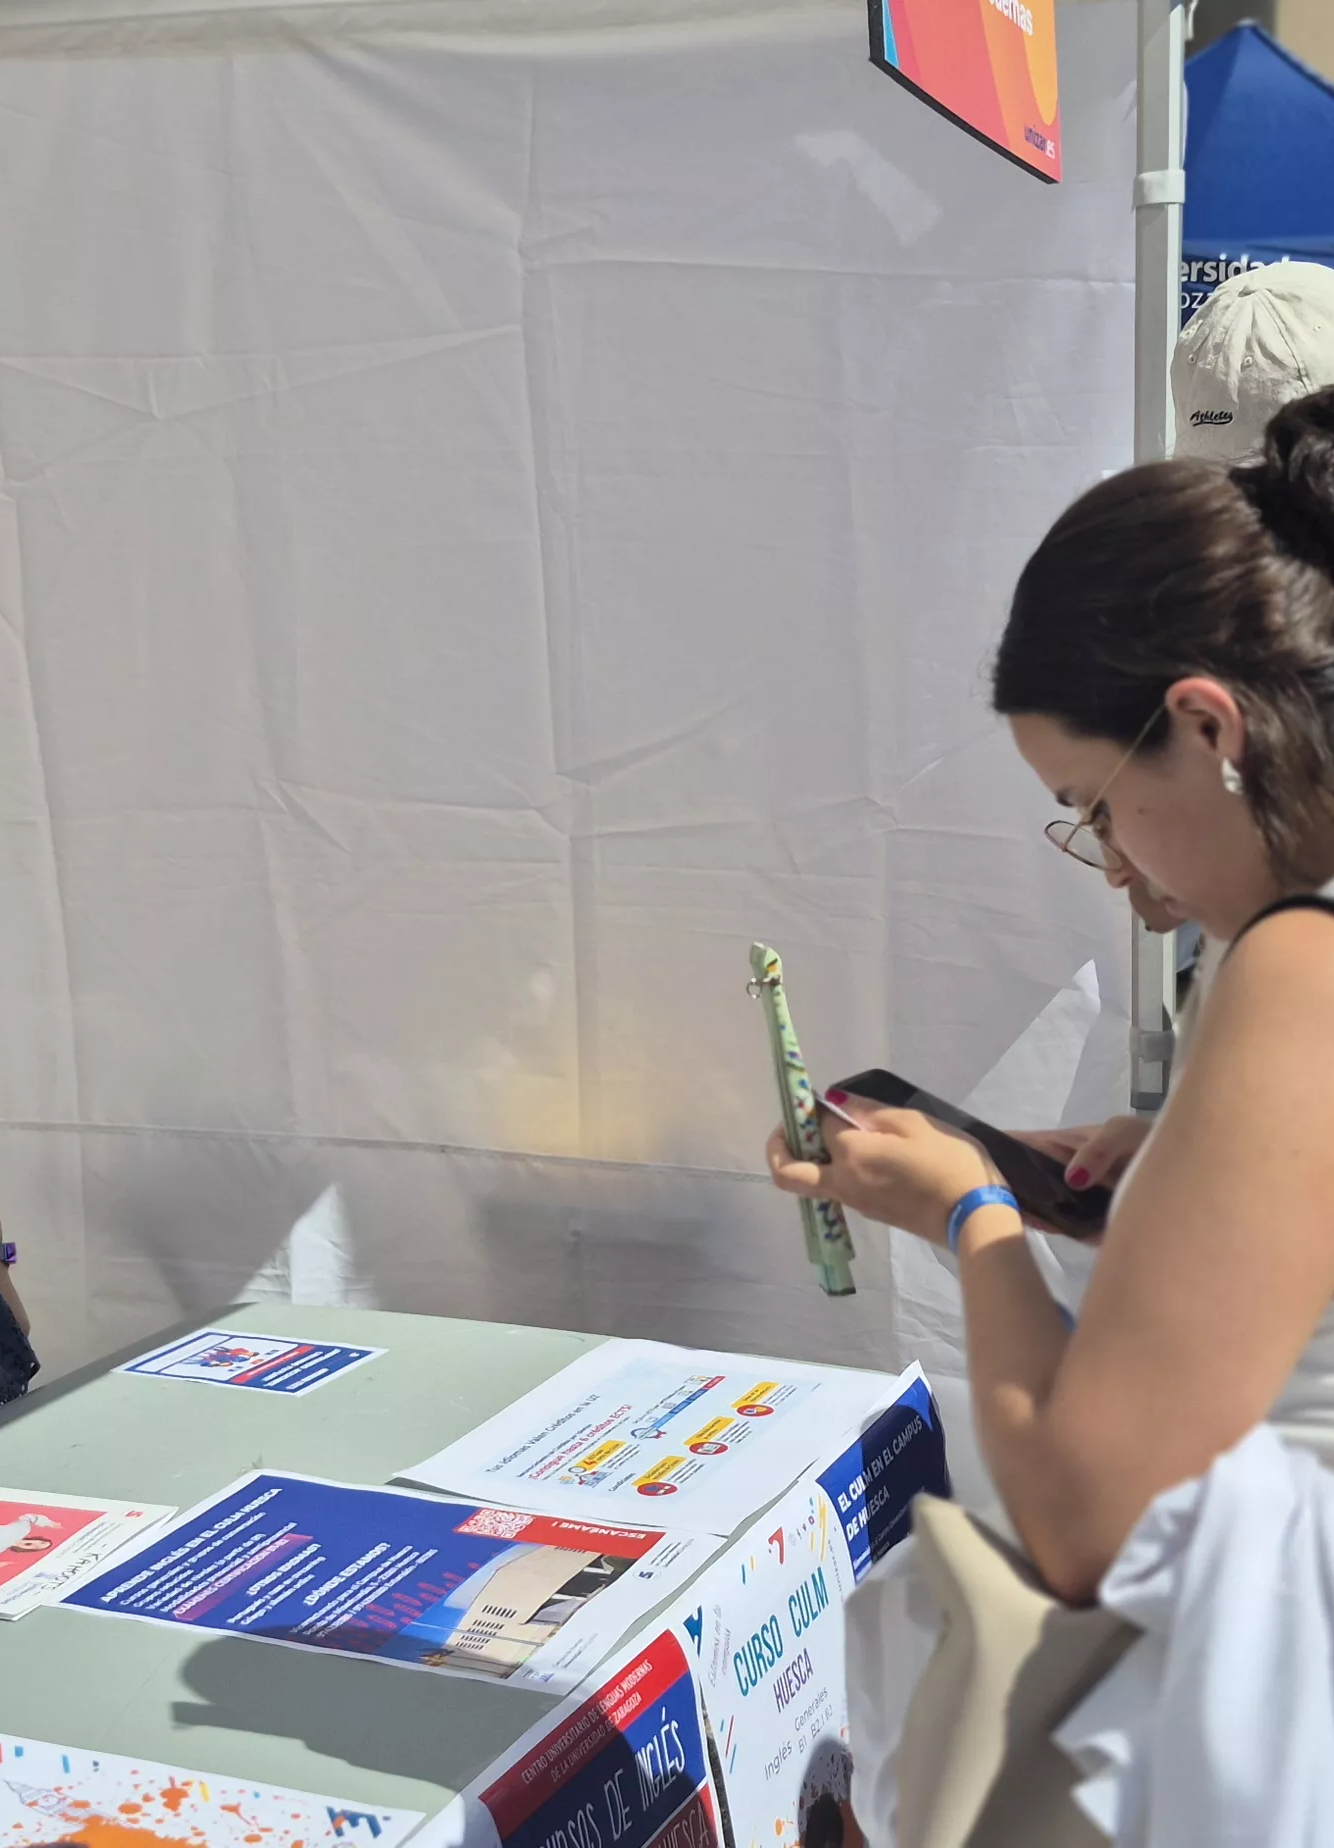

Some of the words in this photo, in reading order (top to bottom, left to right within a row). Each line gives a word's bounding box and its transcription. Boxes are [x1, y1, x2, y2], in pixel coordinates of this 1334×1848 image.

[837, 1491, 851, 1513] EL
[848, 1468, 872, 1501] CULM
[872, 1458, 884, 1479] EN
[882, 1447, 894, 1466] EL
[892, 1414, 923, 1455] CAMPUS
[101, 1571, 154, 1602] APRENDE
[150, 1548, 190, 1570] INGLÉS
[185, 1538, 205, 1547] EN
[200, 1529, 219, 1537] EL
[214, 1512, 245, 1529] CULM
[240, 1489, 282, 1512] HUESCA
[560, 1521, 647, 1540] ESCANÉAME
[845, 1519, 859, 1542] DE
[858, 1485, 890, 1525] HUESCA
[304, 1576, 346, 1605] ¿DÓNDE
[340, 1543, 390, 1576] ESTAMOS?
[733, 1614, 784, 1697] CURSO
[788, 1565, 830, 1638] CULM
[773, 1647, 814, 1714] HUESCA
[794, 1687, 828, 1731] Generales
[521, 1756, 548, 1785] CENTRO
[546, 1716, 590, 1764] UNIVERSITARIO
[589, 1709, 600, 1726] DE
[598, 1687, 624, 1715] LENGUAS
[622, 1658, 653, 1695] MODERNAS
[550, 1768, 561, 1783] DE
[559, 1759, 570, 1774] LA
[568, 1725, 608, 1768] UNIVERSIDAD
[606, 1717, 616, 1733] DE
[613, 1691, 643, 1726] ZARAGOZA
[765, 1739, 793, 1781] Inglés
[603, 1768, 633, 1841] DE
[635, 1706, 686, 1812] INGLÉS
